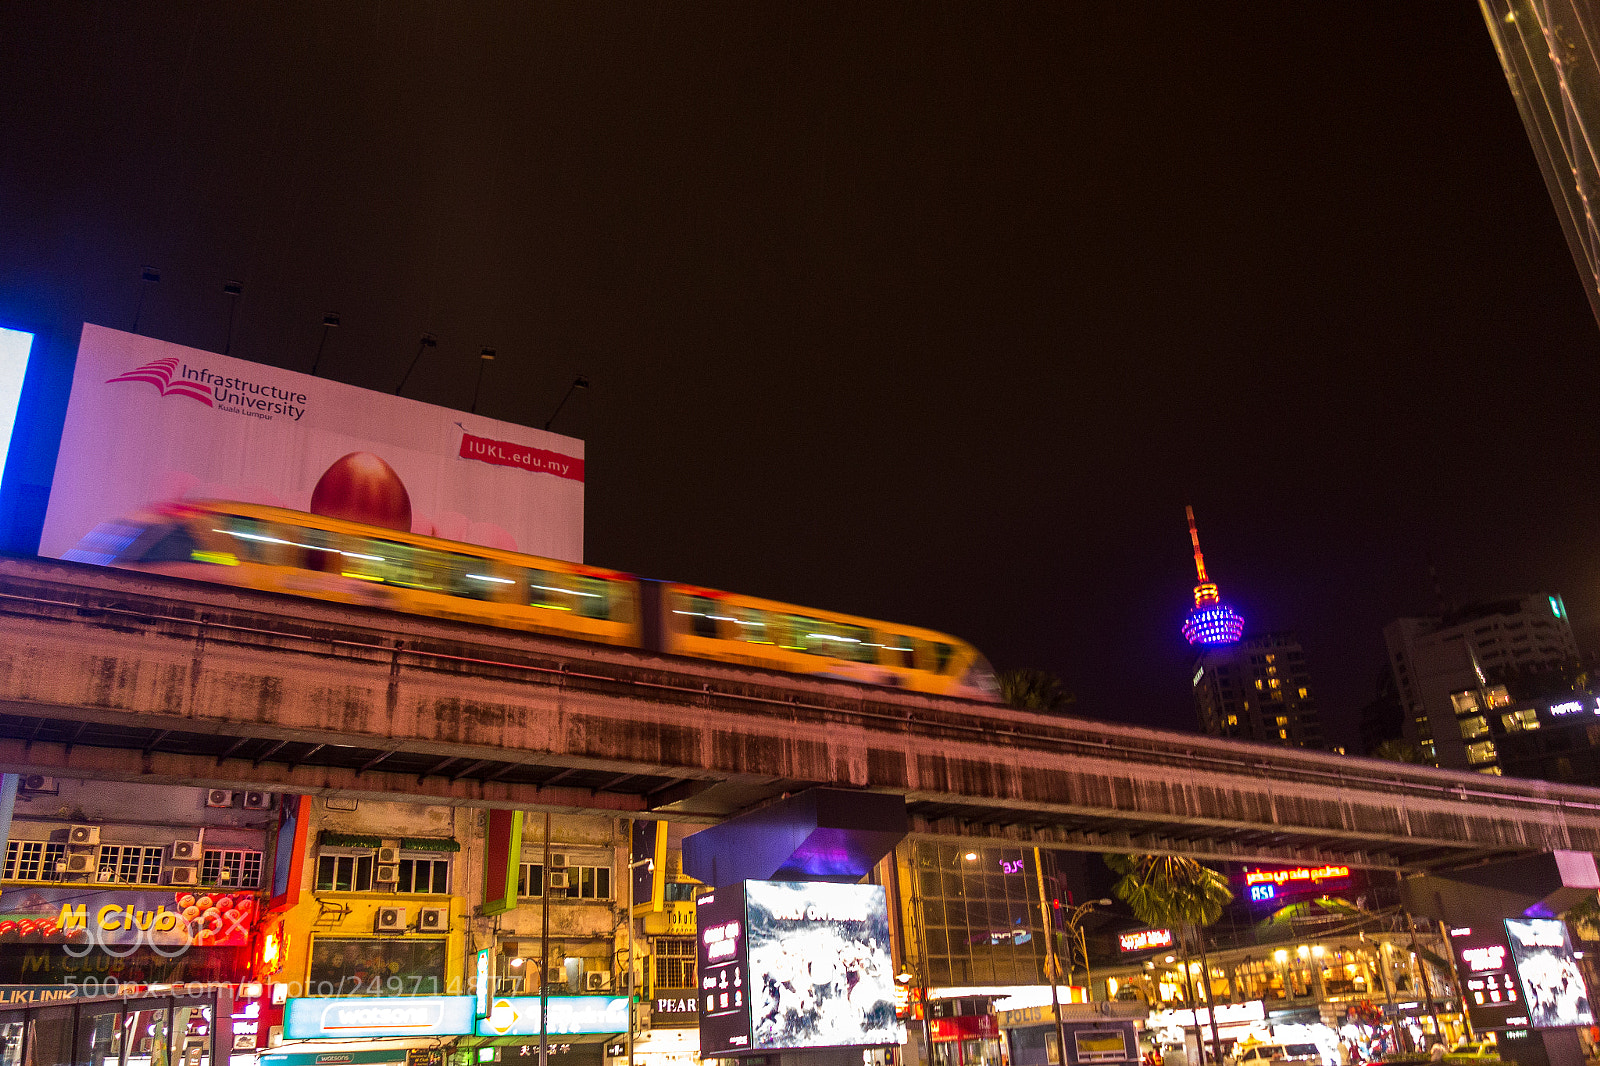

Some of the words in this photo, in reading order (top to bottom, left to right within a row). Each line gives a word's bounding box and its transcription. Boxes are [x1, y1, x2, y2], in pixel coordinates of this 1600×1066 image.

[182, 364, 307, 405] Infrastructure
[214, 387, 305, 420] University
[218, 404, 240, 415] Kuala
[242, 408, 273, 421] Lumpur
[469, 441, 569, 474] IUKL.edu.my
[56, 904, 86, 929] M
[97, 904, 178, 932] Club
[657, 998, 699, 1013] PEAR
[338, 1007, 428, 1025] watsons
[1006, 1008, 1042, 1023] POLIS
[321, 1055, 349, 1063] watsons
